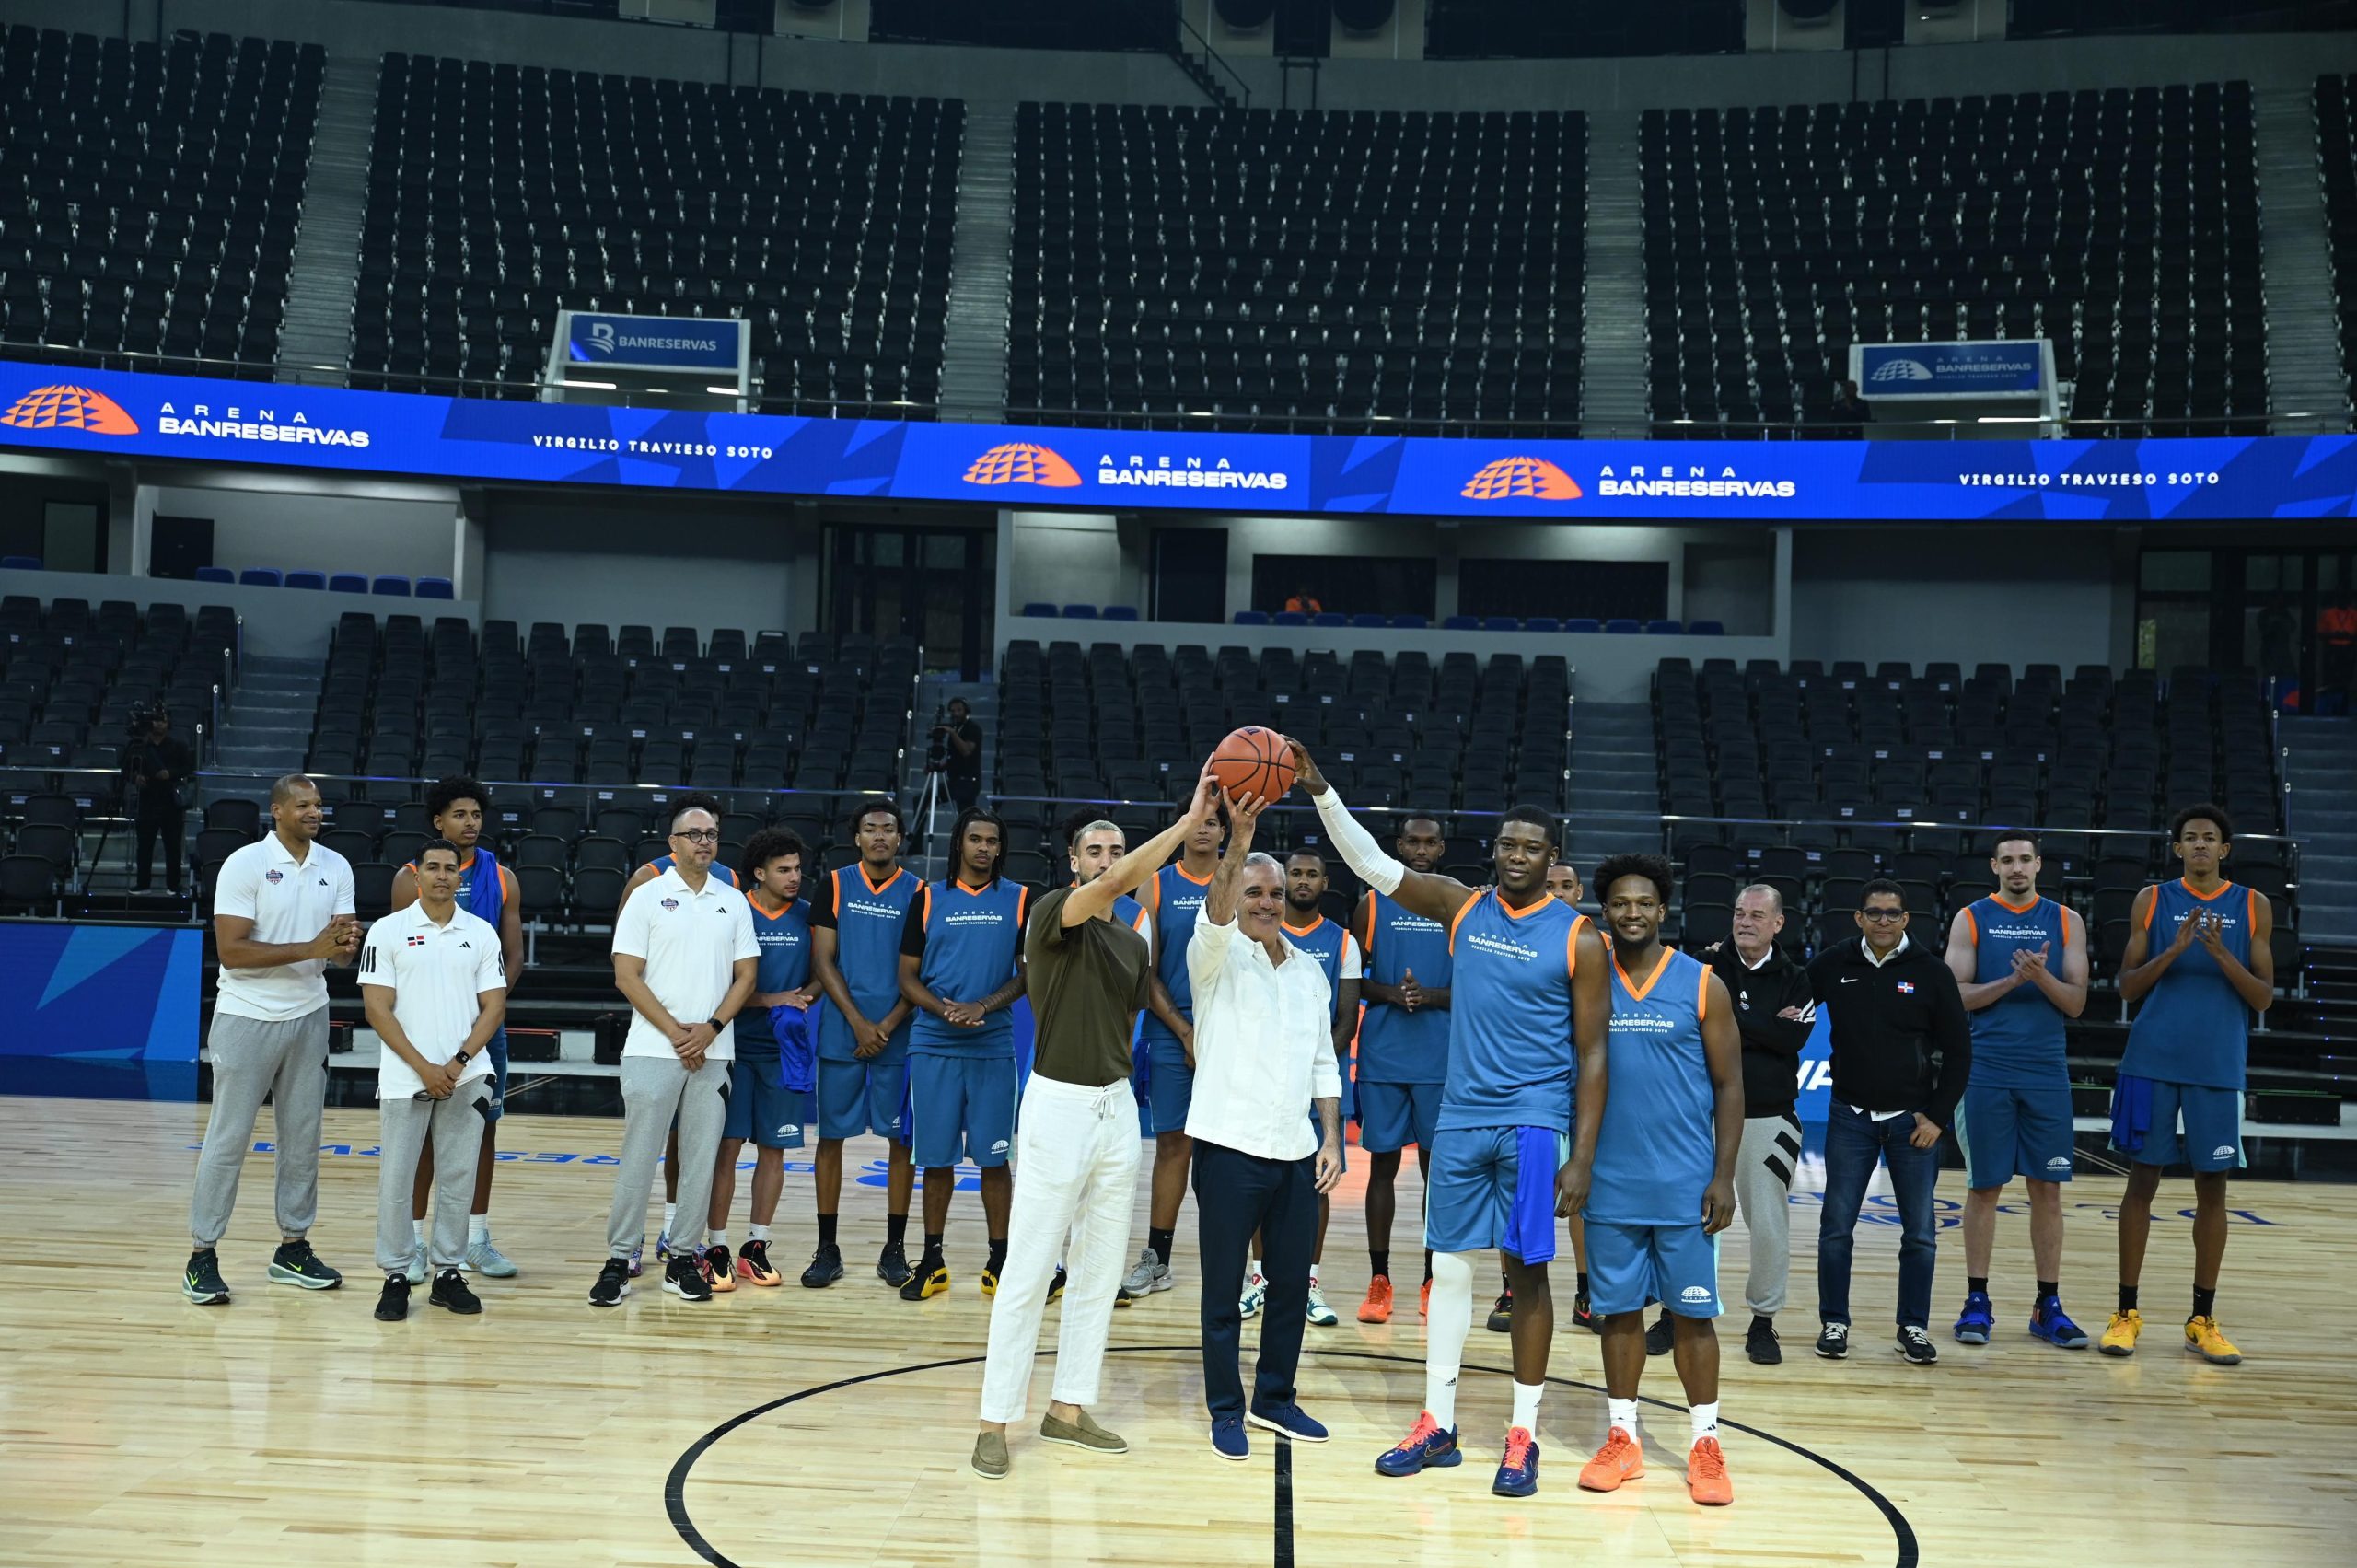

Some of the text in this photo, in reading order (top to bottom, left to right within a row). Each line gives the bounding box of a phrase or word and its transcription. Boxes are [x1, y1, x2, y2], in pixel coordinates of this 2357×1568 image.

[619, 336, 717, 351] BANRESERVAS
[1936, 363, 2032, 373] BANRESERVAS
[160, 401, 308, 424] ARENA
[158, 416, 370, 447] BANRESERVAS
[533, 435, 772, 459] VIRGILIO TRAVIESO SOTO
[1099, 454, 1230, 470] ARENA
[1098, 468, 1288, 490] BANRESERVAS
[1599, 465, 1736, 478] ARENA
[1958, 471, 2220, 486] VIRGILIO TRAVIESO SOTO
[1598, 480, 1796, 497] BANRESERVAS
[848, 902, 901, 916] BANRESERVAS
[1988, 928, 2048, 936] BANRESERVAS
[1468, 935, 1538, 958] BANRESERVAS
[1480, 932, 1528, 949] ARENA
[1609, 1019, 1675, 1028] ANRESERVAS
